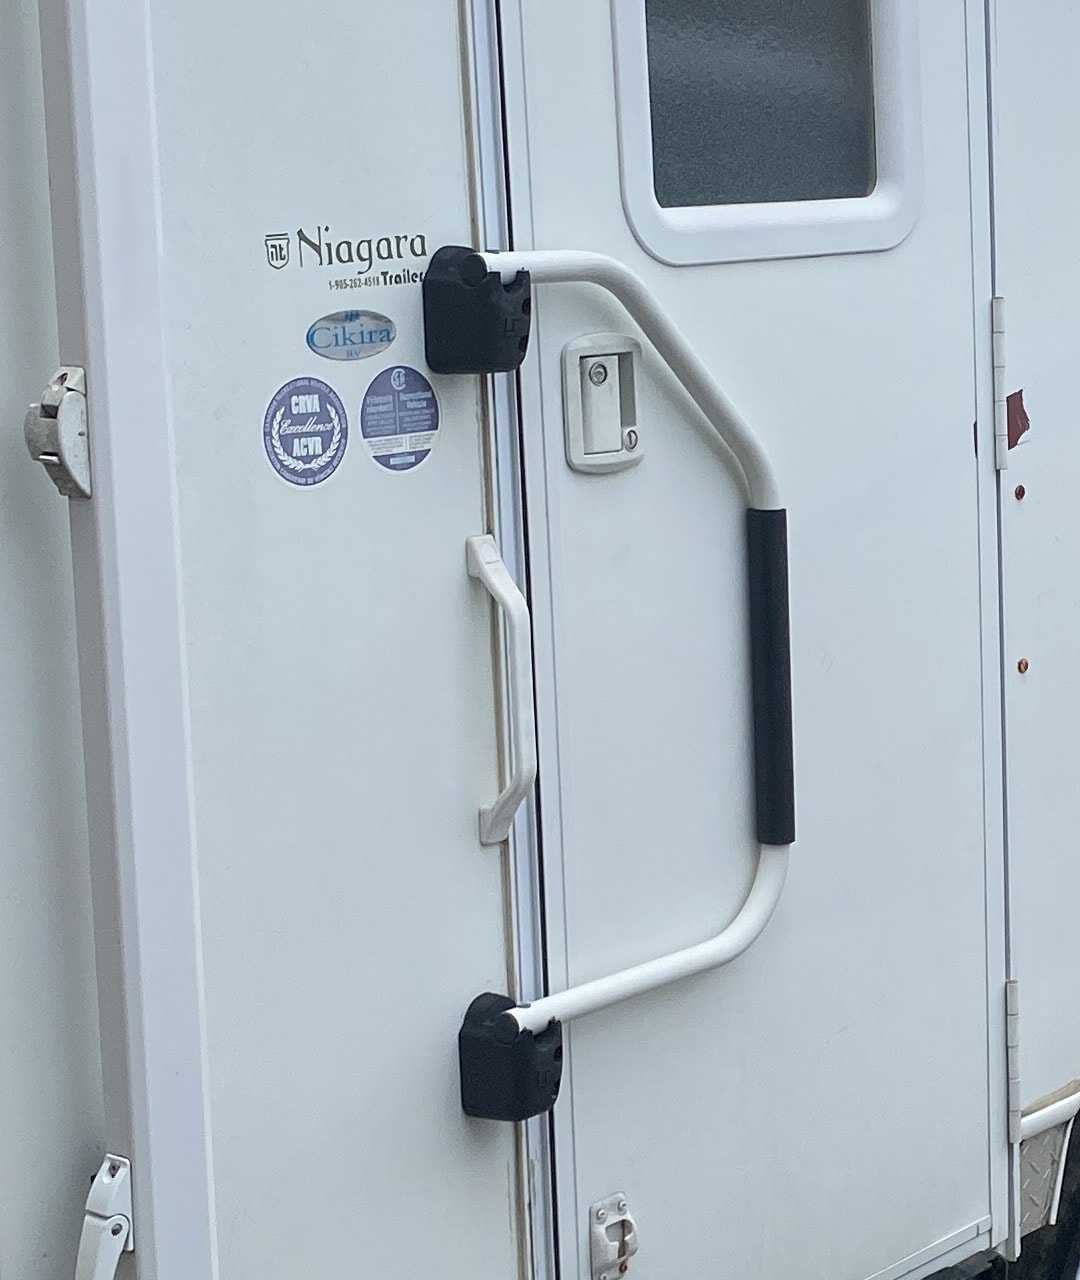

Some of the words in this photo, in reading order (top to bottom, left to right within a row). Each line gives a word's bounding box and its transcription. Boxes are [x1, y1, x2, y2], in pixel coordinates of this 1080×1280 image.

[297, 225, 428, 275] Niagara
[309, 324, 395, 348] Cikira
[346, 349, 361, 358] RV
[290, 394, 320, 414] CRVA
[280, 416, 334, 435] Excellence
